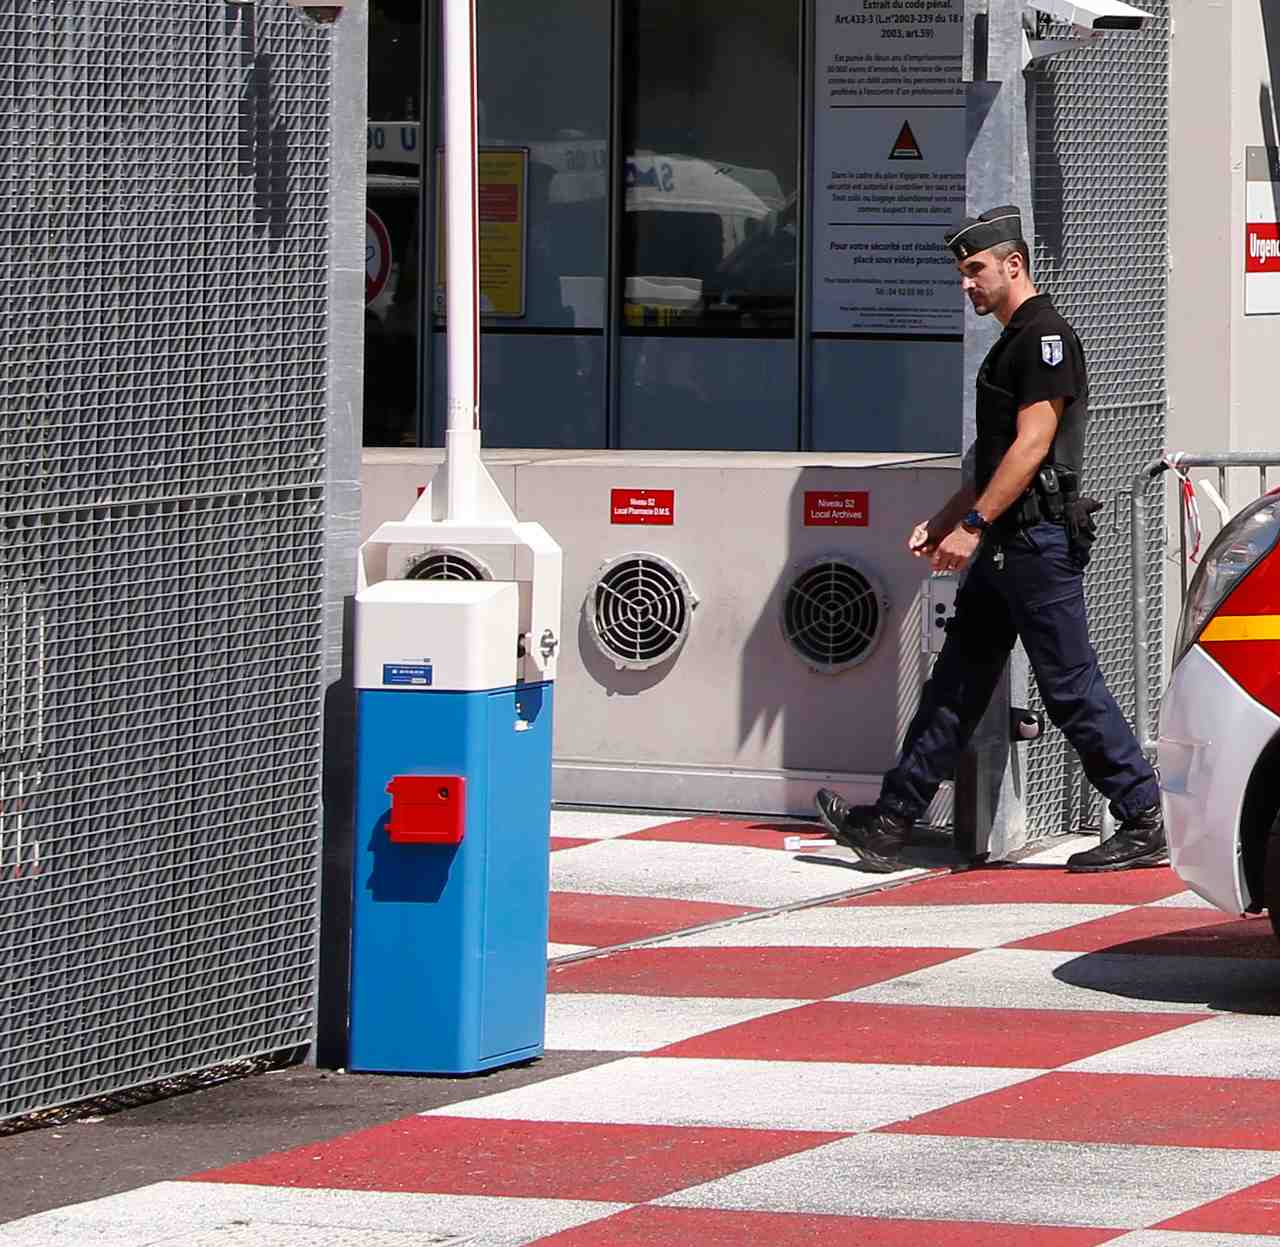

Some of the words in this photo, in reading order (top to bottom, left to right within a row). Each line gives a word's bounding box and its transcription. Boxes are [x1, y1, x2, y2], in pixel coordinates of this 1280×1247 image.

[863, 0, 890, 9] Extrait
[893, 0, 903, 9] du
[905, 0, 925, 9] code
[811, 510, 831, 519] Local
[832, 510, 863, 519] Archives
